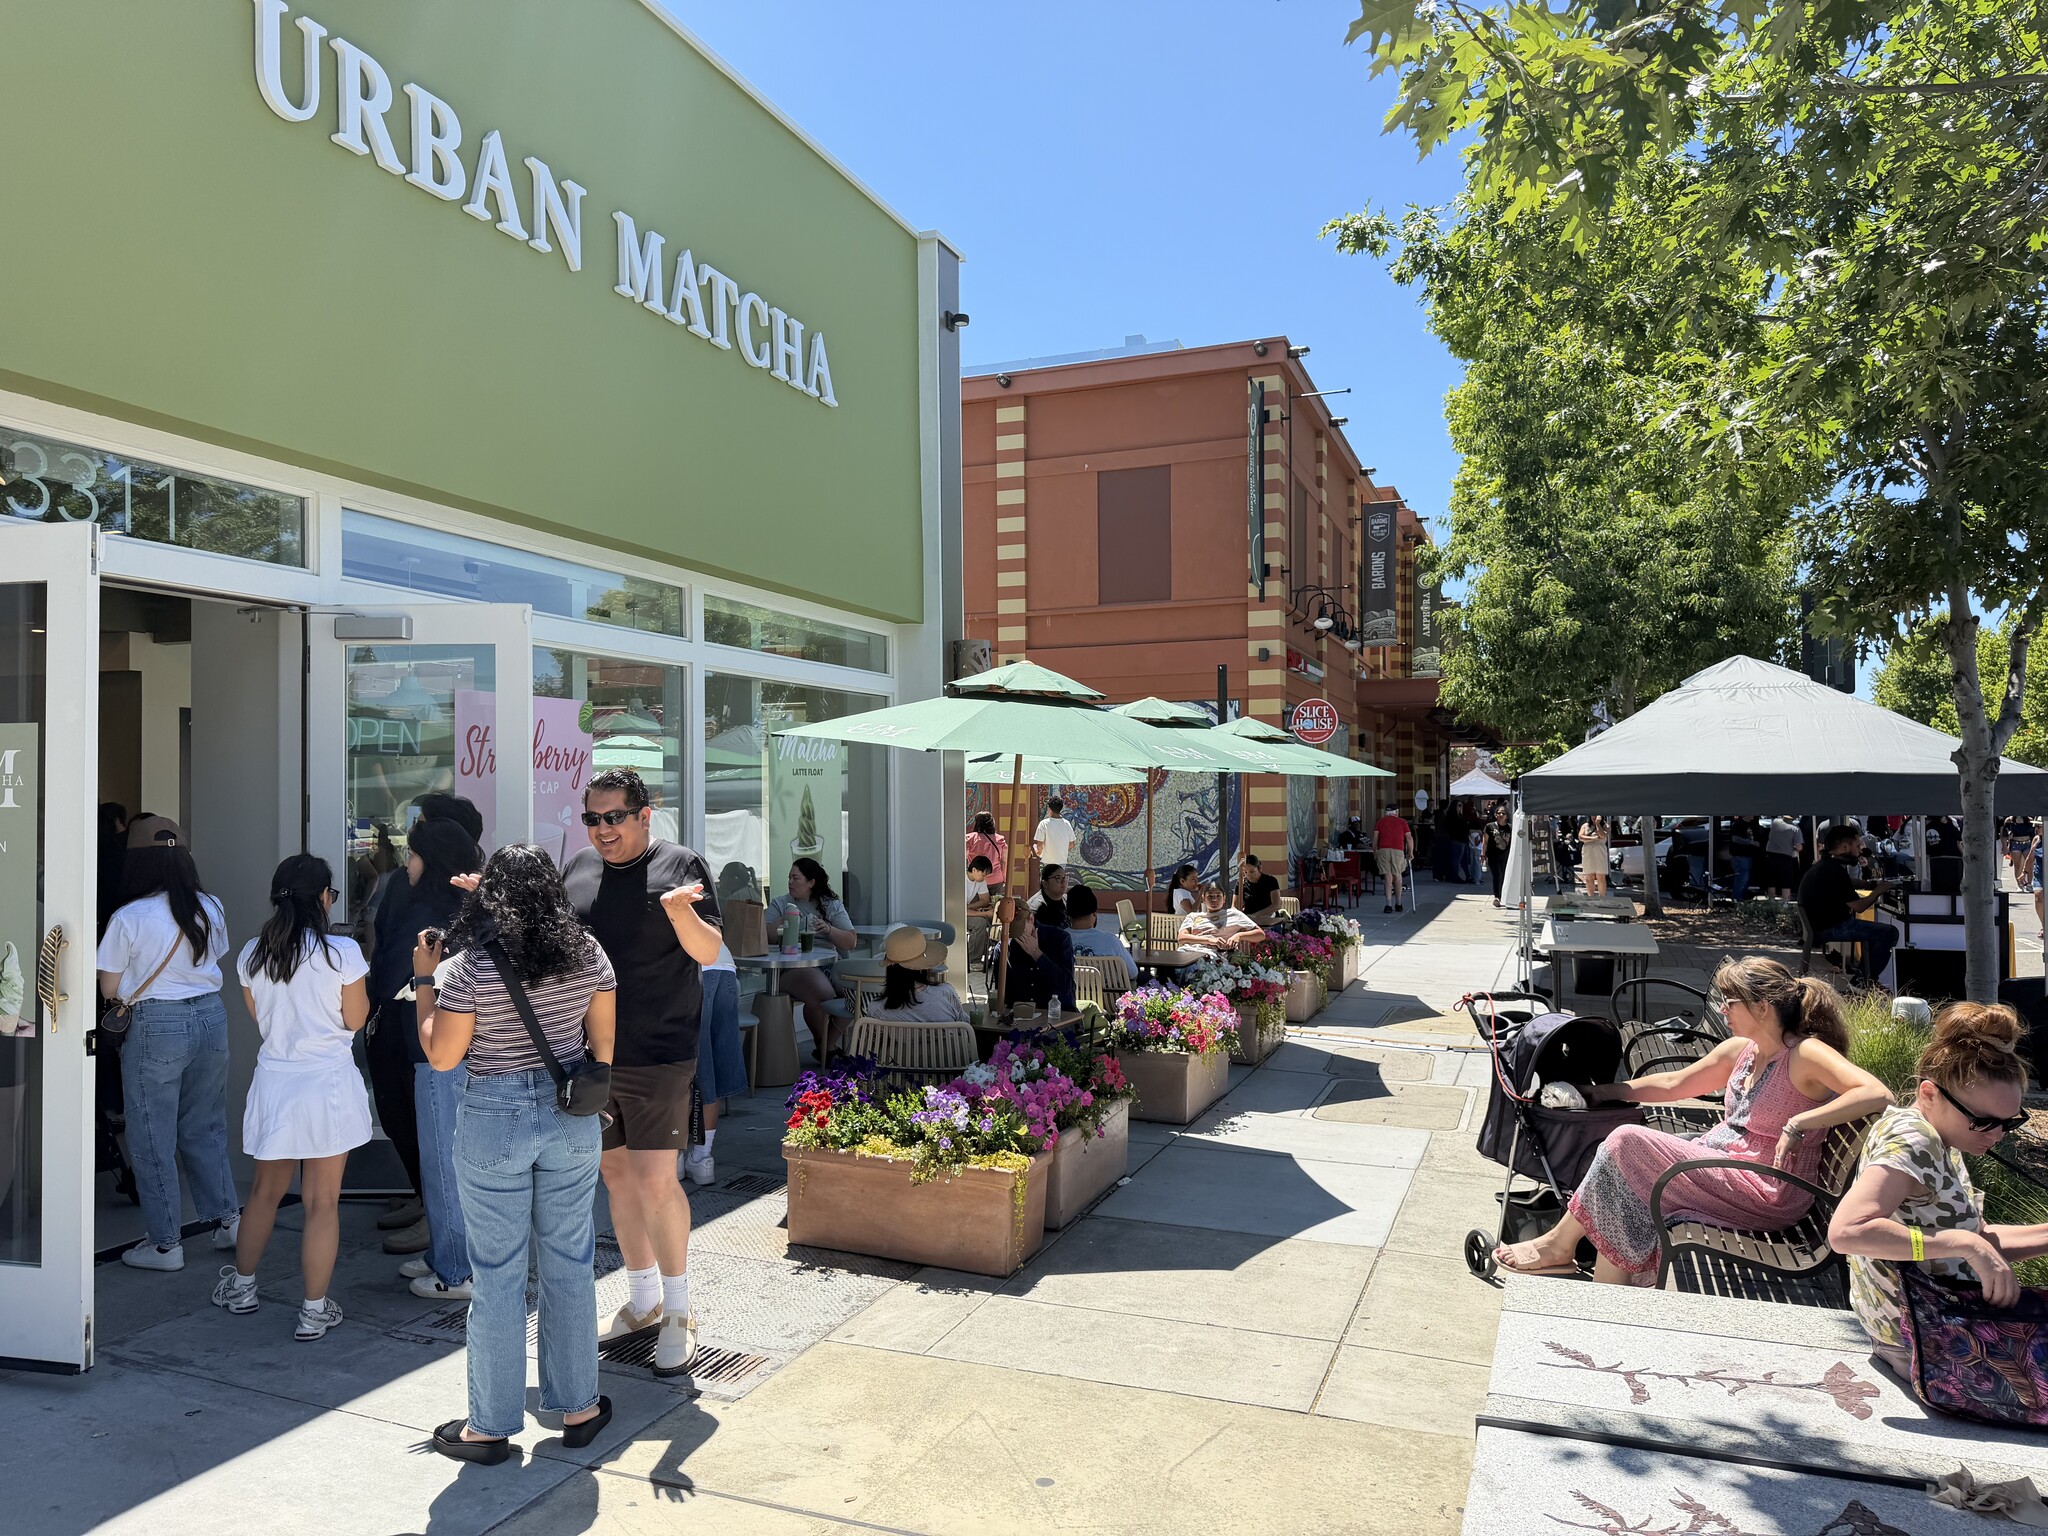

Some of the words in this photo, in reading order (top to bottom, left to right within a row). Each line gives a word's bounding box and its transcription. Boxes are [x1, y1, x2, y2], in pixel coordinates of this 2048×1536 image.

[254, 0, 588, 272] URBAN
[612, 210, 839, 408] MATCHA
[6, 441, 176, 541] 3311
[1371, 551, 1386, 590] BARONS
[1299, 705, 1330, 718] SLICE
[460, 718, 589, 790] Strberry
[778, 735, 838, 763] Matcha
[540, 781, 560, 794] CAP
[792, 768, 808, 776] LATTE
[808, 768, 824, 776] FLOAT
